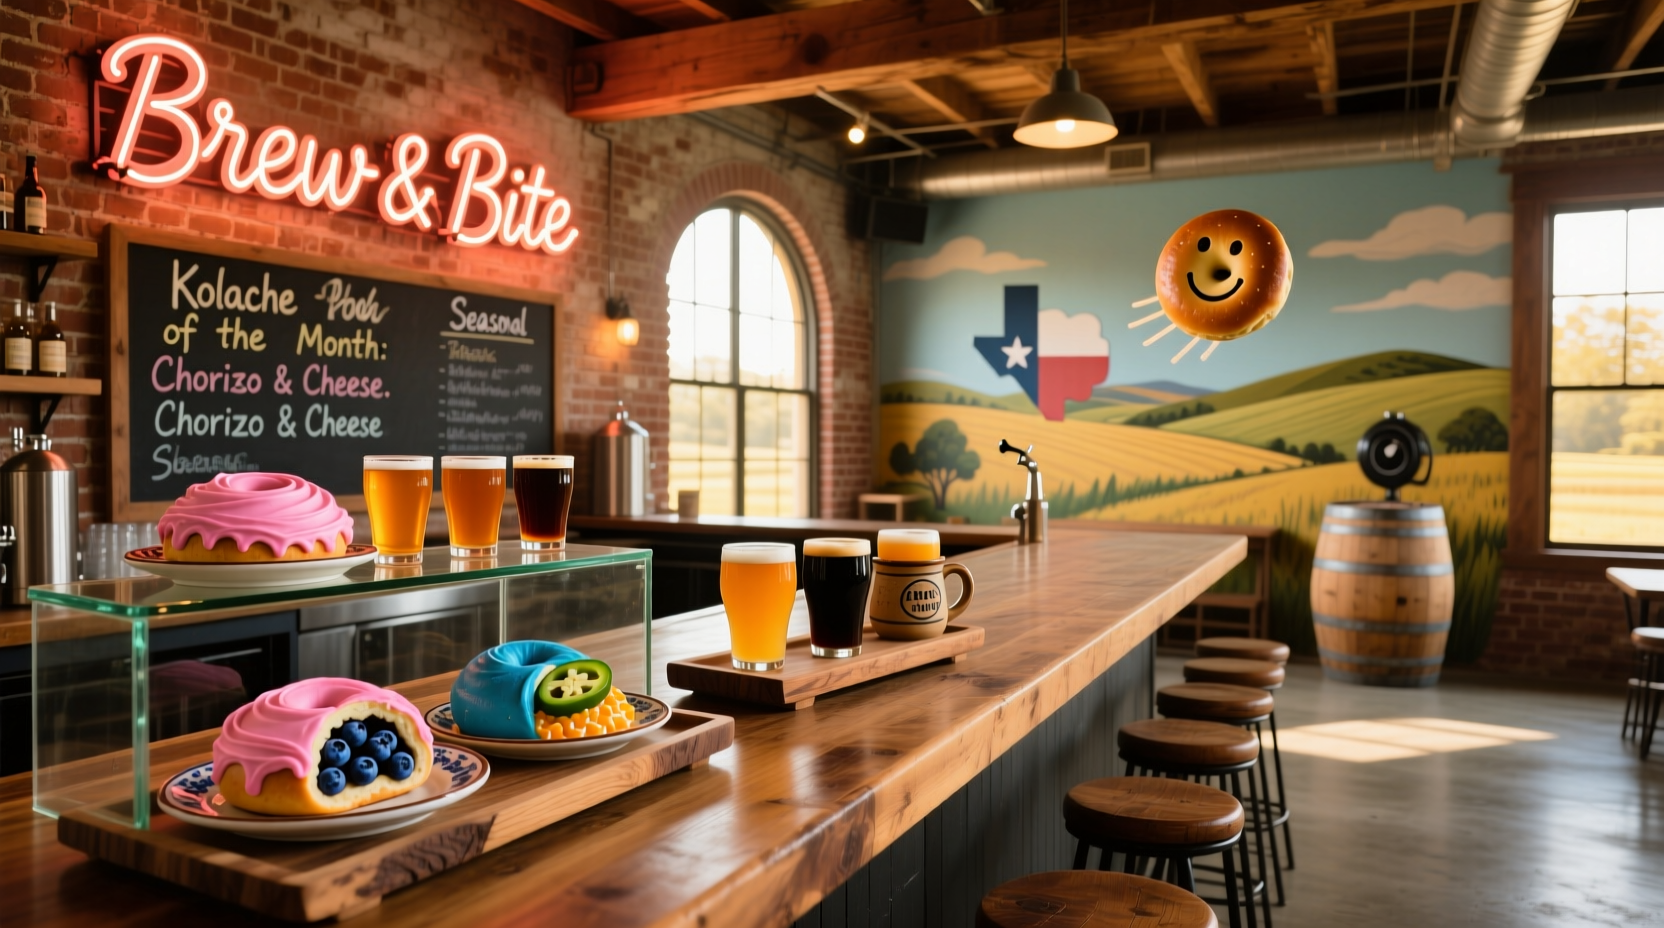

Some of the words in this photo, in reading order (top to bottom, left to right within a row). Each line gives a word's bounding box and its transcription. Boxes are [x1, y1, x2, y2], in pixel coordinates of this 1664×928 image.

[101, 33, 380, 211] Brew
[378, 133, 433, 232] &
[445, 132, 579, 254] Bite
[171, 258, 299, 316] Kolache
[163, 313, 198, 354] of
[216, 317, 266, 352] the
[296, 322, 388, 361] Month:
[151, 354, 263, 395] Chorizo
[273, 364, 294, 396] &
[302, 363, 391, 400] Cheese.
[154, 400, 265, 438] Chorizo
[276, 404, 297, 438] &
[304, 403, 384, 438] Cheese
